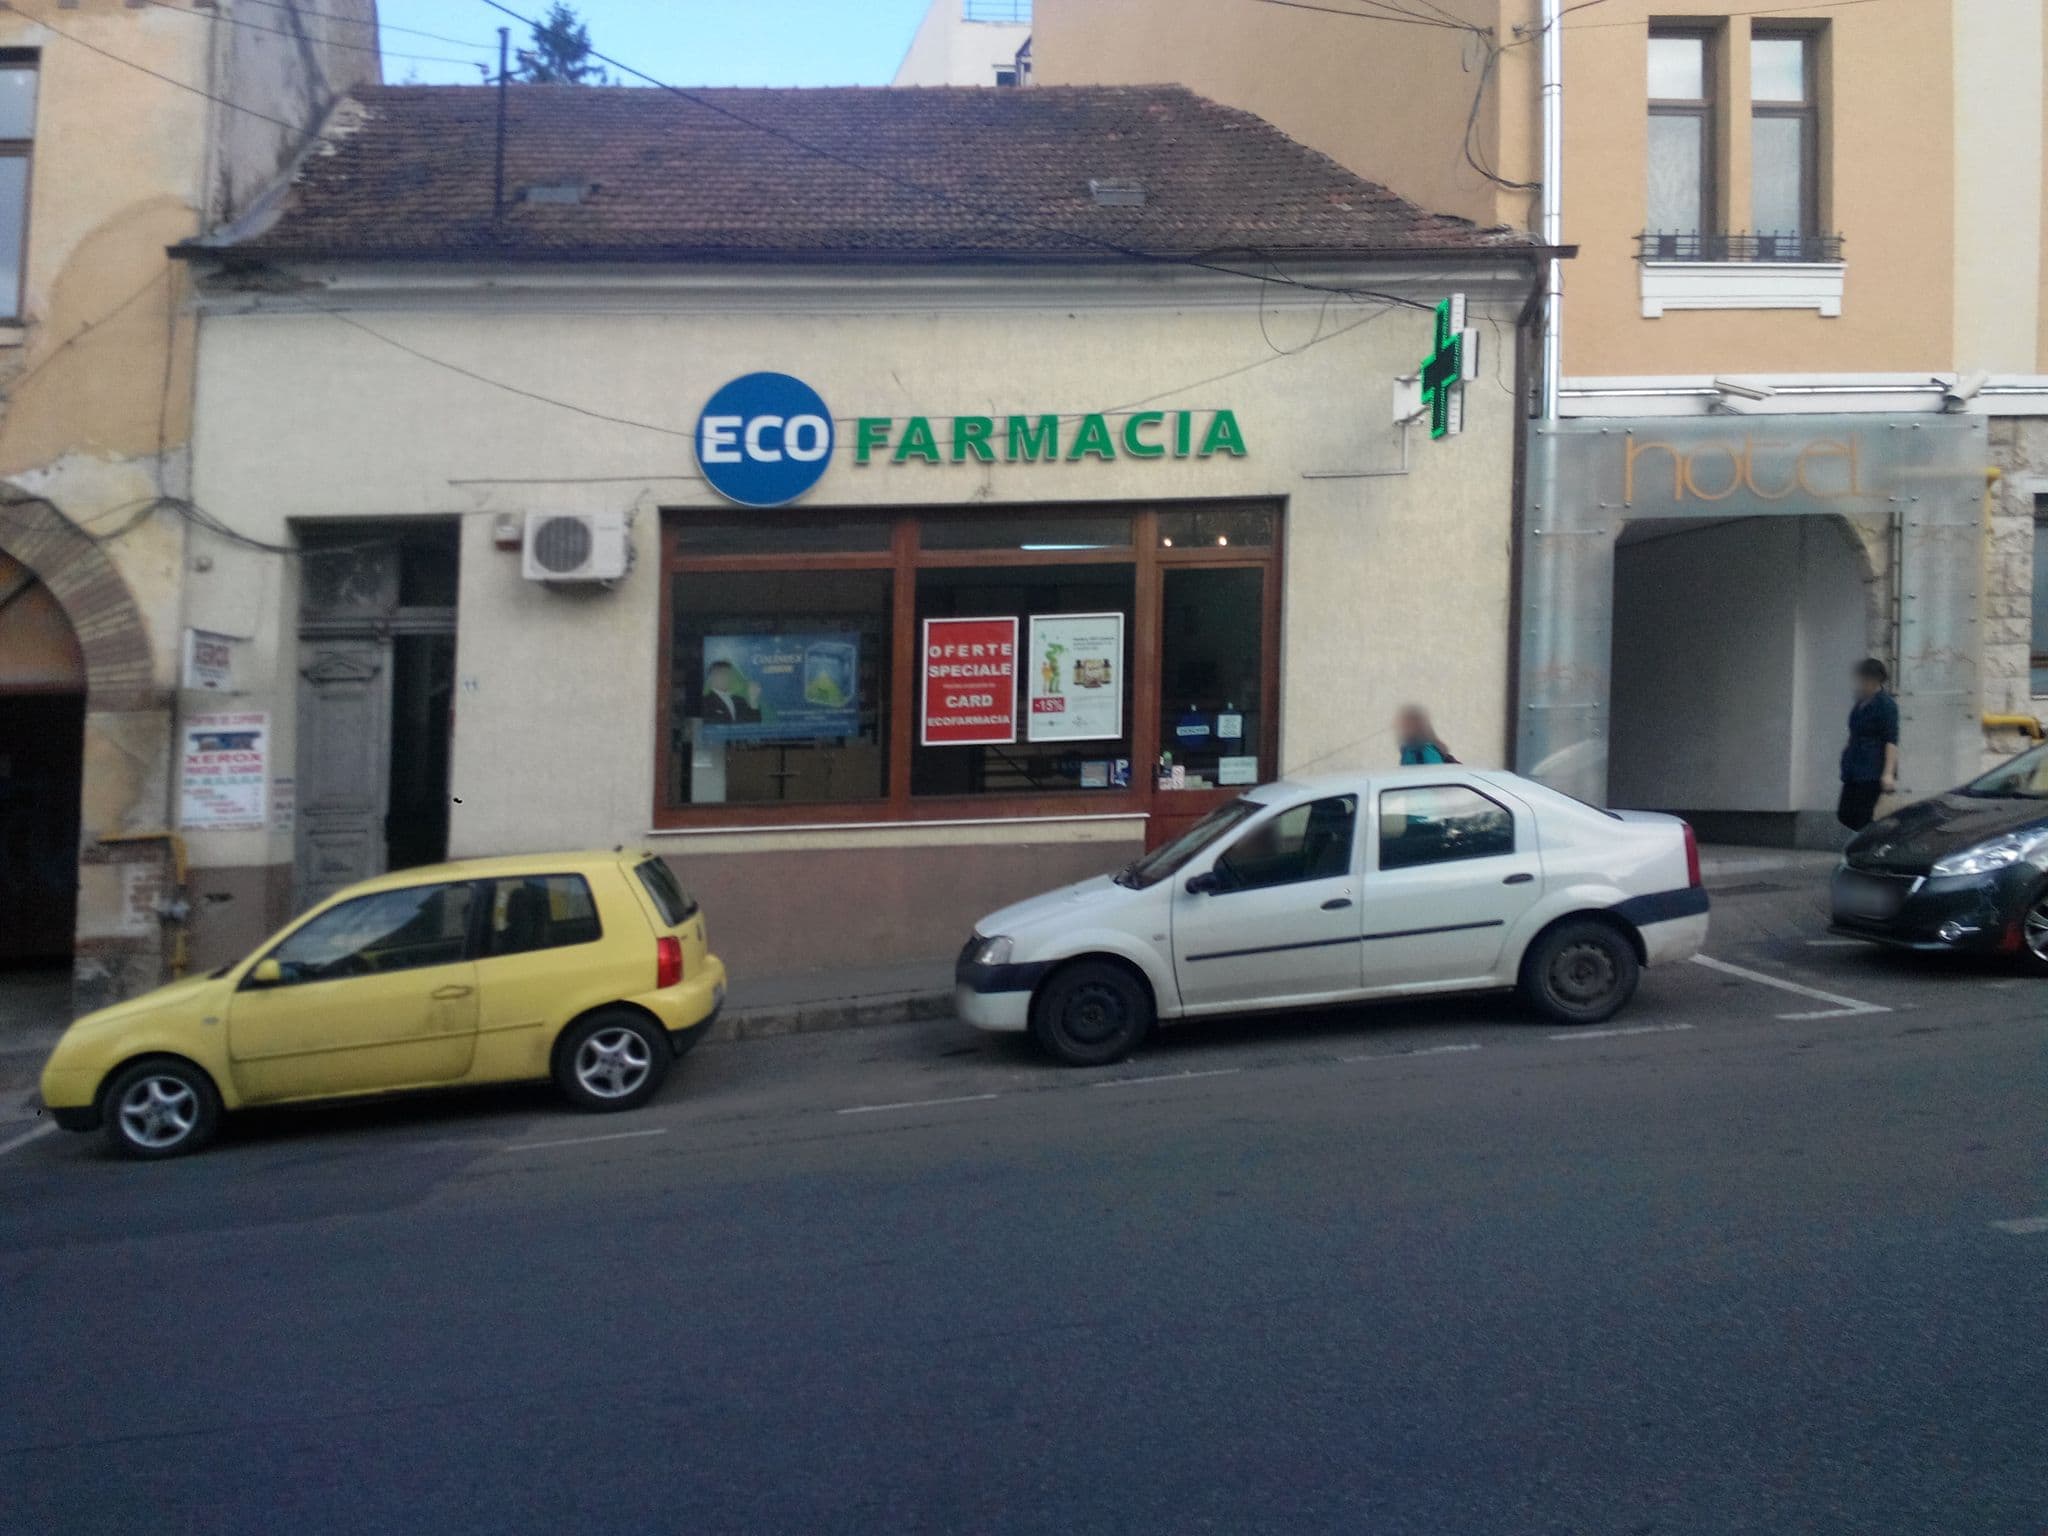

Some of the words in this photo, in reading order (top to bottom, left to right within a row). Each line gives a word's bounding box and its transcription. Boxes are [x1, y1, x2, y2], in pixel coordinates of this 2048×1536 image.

[701, 415, 830, 464] ECO
[854, 409, 1247, 464] FARMACIA
[1624, 432, 1890, 501] hotel
[929, 643, 1013, 658] OFERTE
[928, 662, 1012, 678] SPECIALE
[945, 694, 994, 708] CARD
[927, 715, 1010, 727] ECOFARMACIA
[186, 753, 262, 764] XEROX
